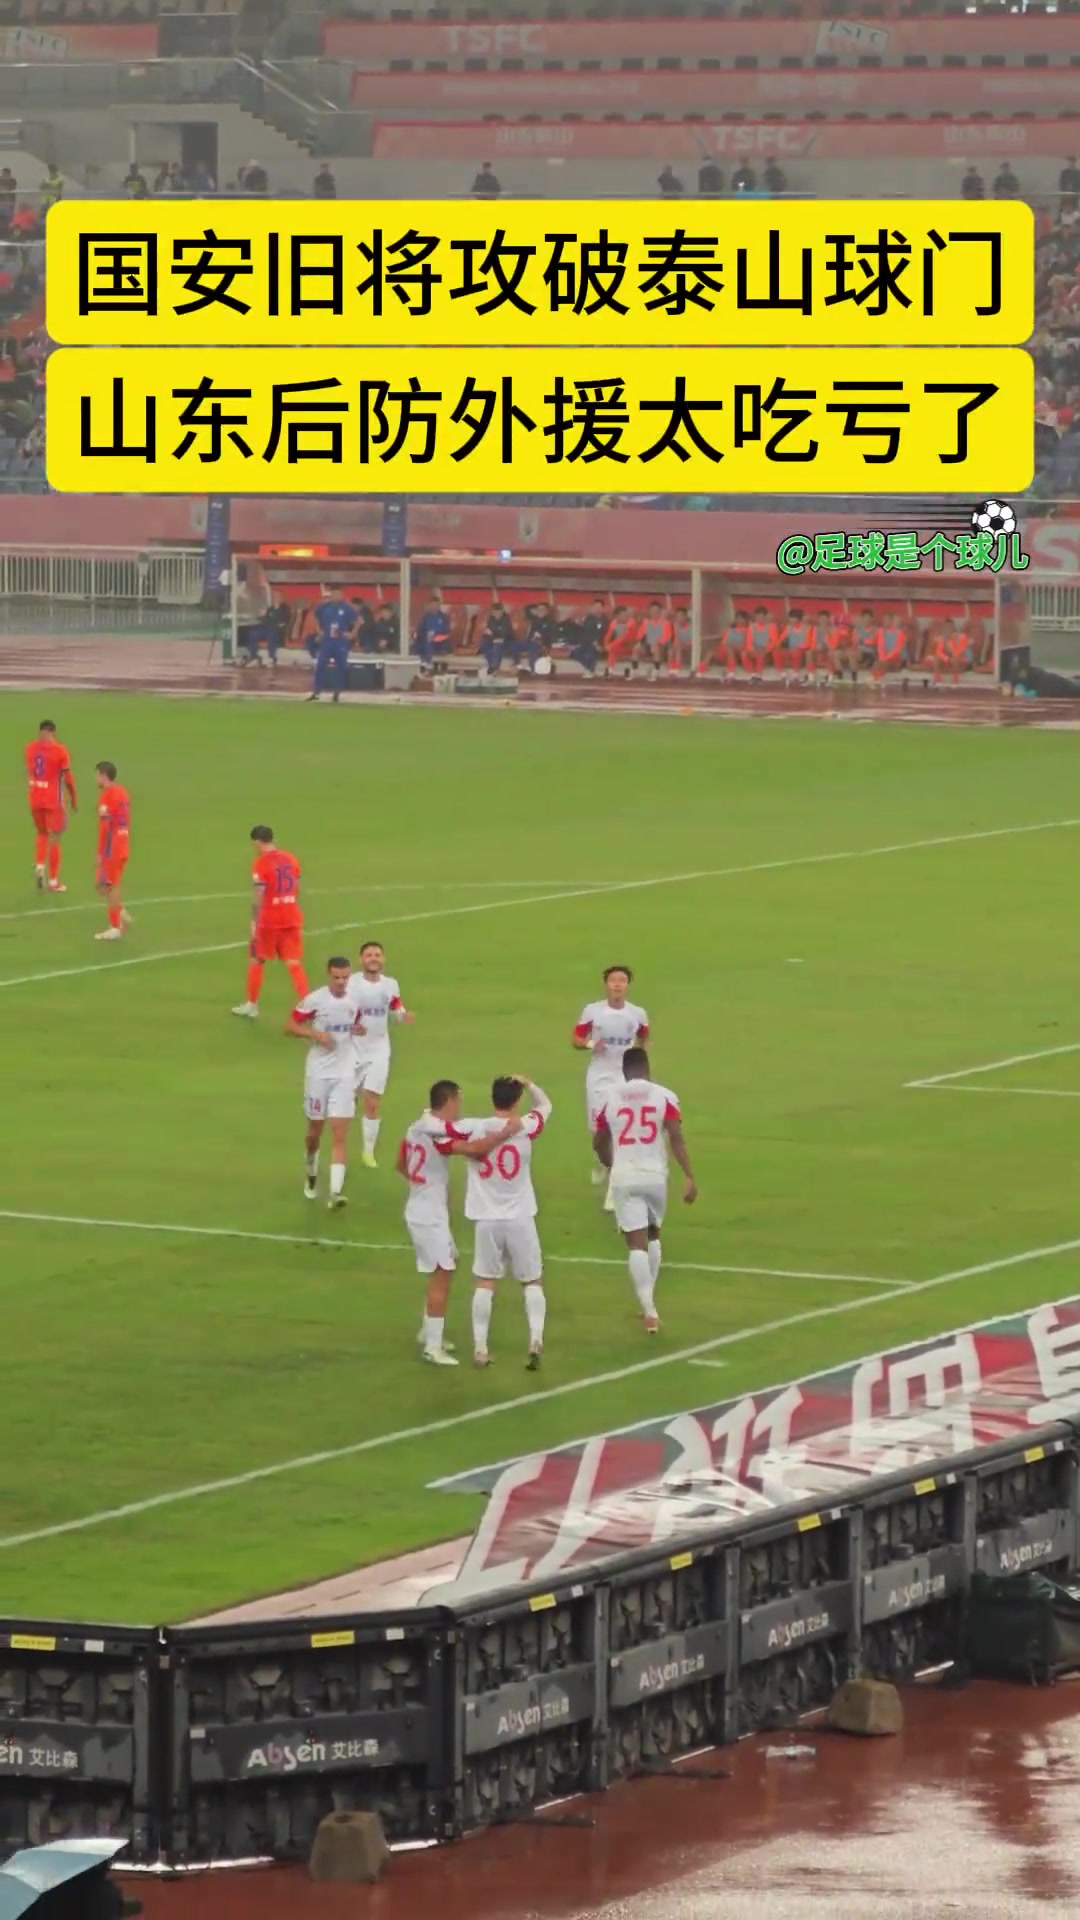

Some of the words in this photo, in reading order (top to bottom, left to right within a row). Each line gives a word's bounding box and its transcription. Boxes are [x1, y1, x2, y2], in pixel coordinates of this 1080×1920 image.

[440, 24, 546, 53] TSFC
[711, 125, 803, 152] TSFC
[276, 864, 295, 893] 15
[617, 1106, 658, 1146] 25
[496, 1705, 541, 1736] Absen
[29, 1747, 79, 1769] 艾比森
[247, 1742, 327, 1772] Absen
[331, 1738, 380, 1761] 艾比森
